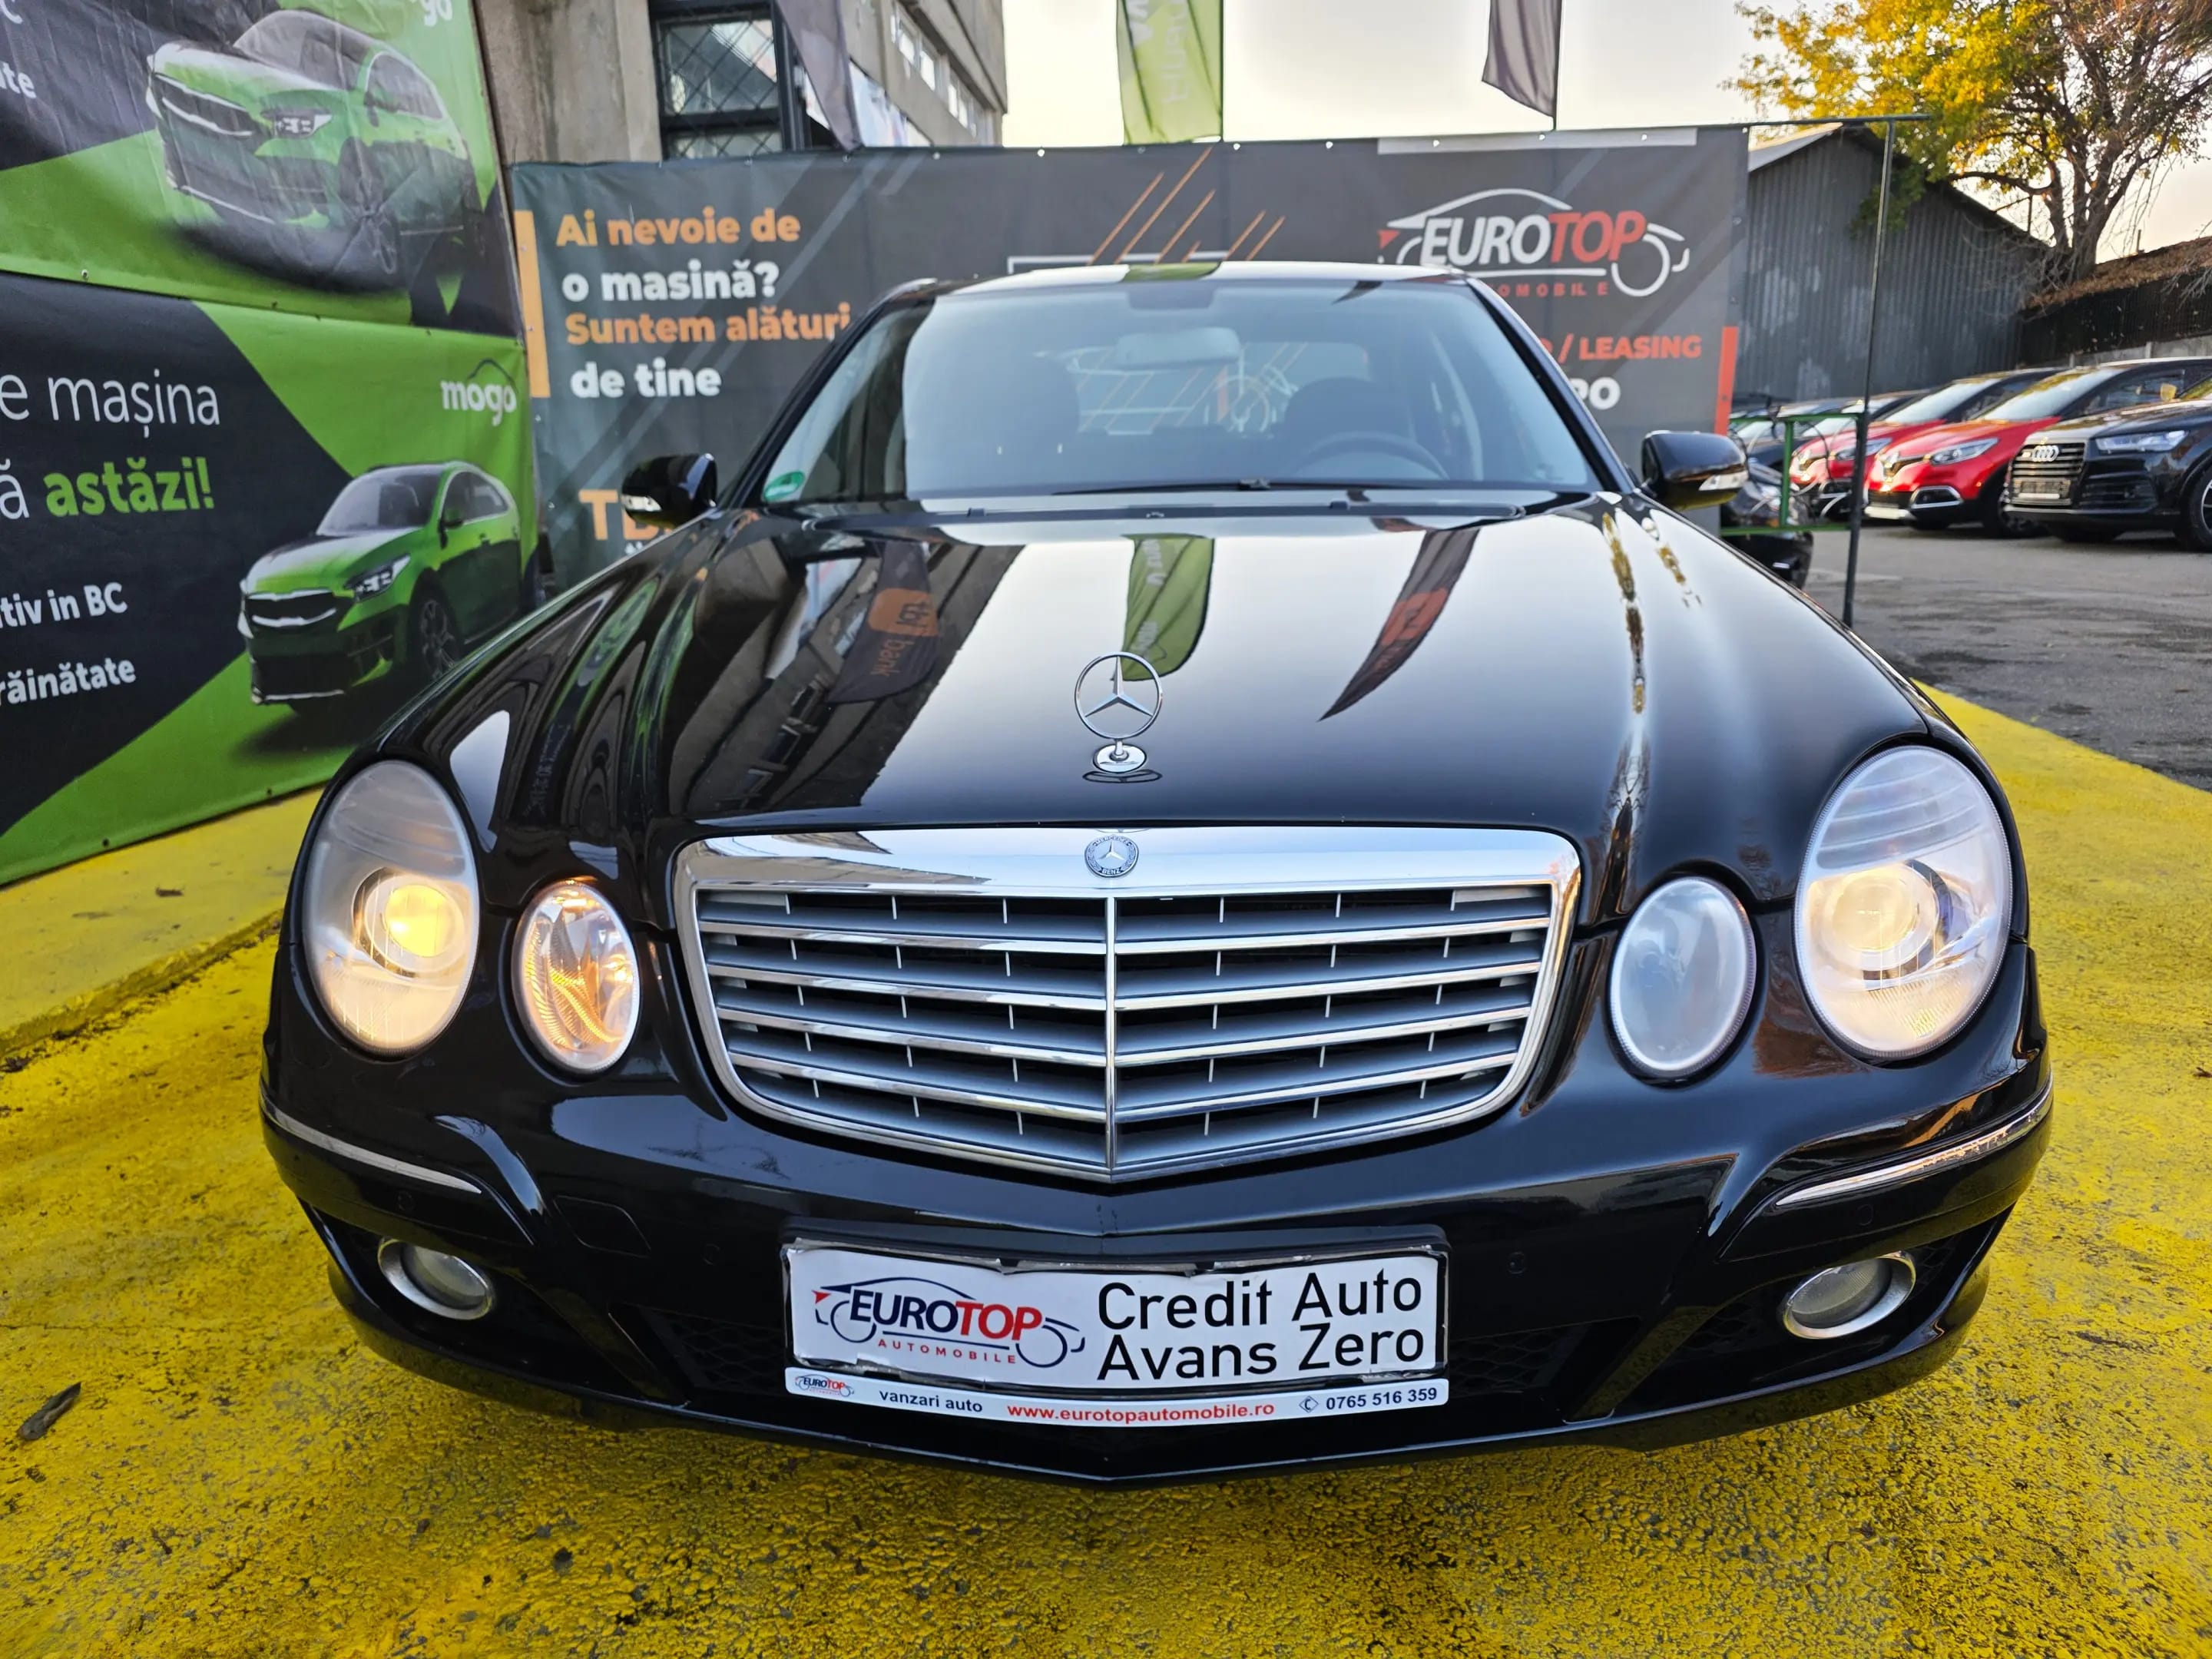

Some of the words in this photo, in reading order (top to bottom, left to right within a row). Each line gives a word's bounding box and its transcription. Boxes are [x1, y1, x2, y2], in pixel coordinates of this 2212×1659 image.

[556, 209, 598, 247] Ai
[607, 206, 741, 246] nevoie
[750, 207, 800, 242] de
[1419, 209, 1647, 267] EUROTOP
[562, 273, 589, 302] o
[601, 258, 780, 301] masină?
[565, 313, 717, 345] Suntem
[726, 302, 851, 343] alături
[1579, 335, 1702, 361] LEASING
[570, 361, 625, 398] de
[634, 356, 722, 397] tine
[0, 374, 30, 420] e
[47, 368, 220, 439] mașina
[440, 379, 518, 427] mogo
[43, 456, 214, 516] astăzi!
[47, 588, 81, 621] in
[83, 581, 128, 616] BC
[849, 1289, 1043, 1341] EUROTOP
[1098, 1280, 1273, 1330] Credit
[1291, 1267, 1422, 1321] Auto
[878, 1339, 1016, 1364] AUTOMOBILE
[1097, 1333, 1277, 1381] Avans
[1298, 1322, 1424, 1371] Zero
[879, 1389, 940, 1408] vanzari
[945, 1397, 982, 1412] auto
[1007, 1401, 1275, 1426] www.eurotopautomobile.ro
[1326, 1395, 1367, 1410] 0765
[1372, 1391, 1402, 1406] 516
[1407, 1387, 1438, 1403] 359
